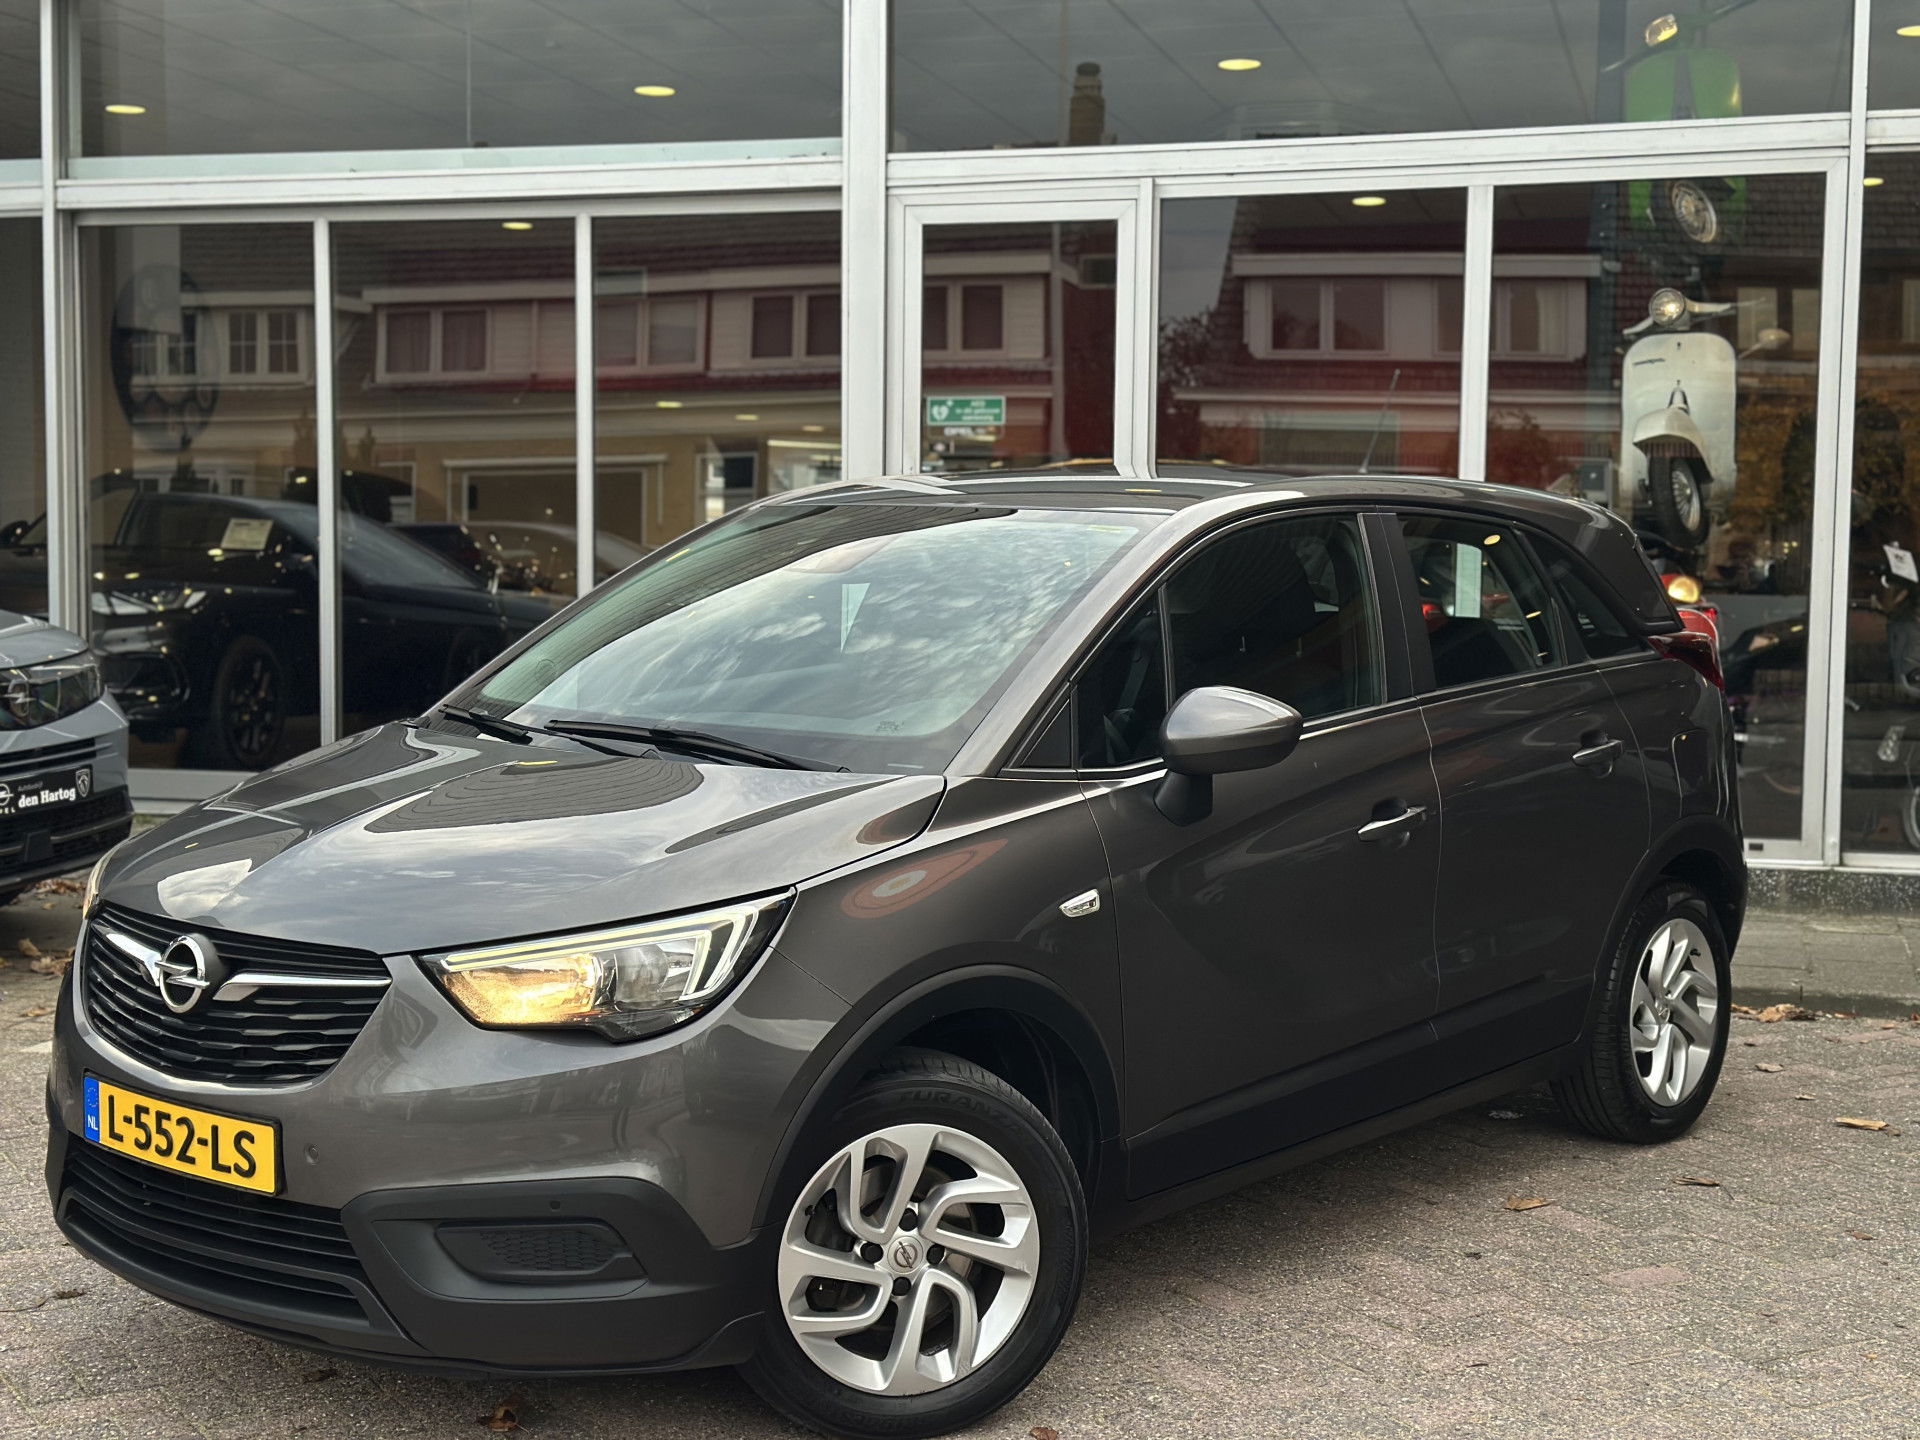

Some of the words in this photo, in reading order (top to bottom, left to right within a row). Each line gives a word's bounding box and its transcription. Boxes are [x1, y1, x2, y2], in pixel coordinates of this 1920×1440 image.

[18, 794, 39, 808] den
[40, 788, 76, 803] Hartog
[87, 1115, 98, 1130] NL
[108, 1095, 256, 1178] L-552-LS
